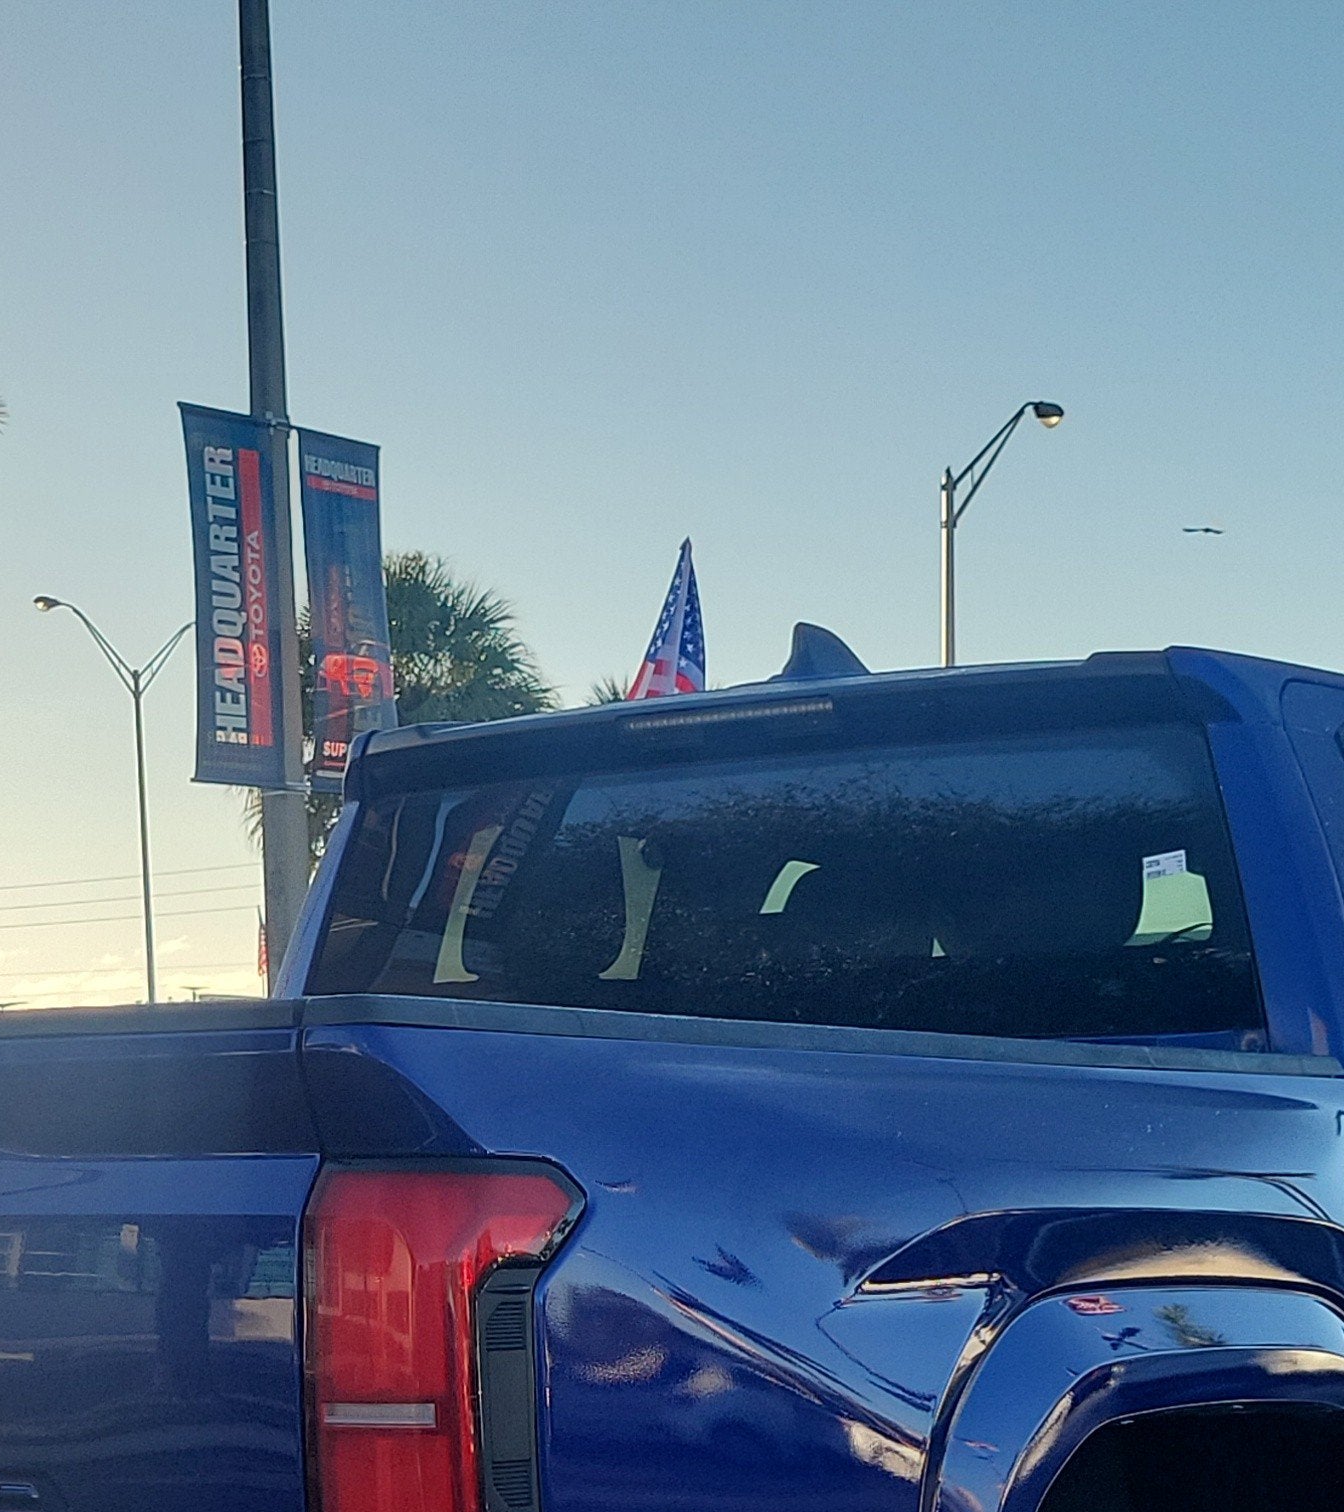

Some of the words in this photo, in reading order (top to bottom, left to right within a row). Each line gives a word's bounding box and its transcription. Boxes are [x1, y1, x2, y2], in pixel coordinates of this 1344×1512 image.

[304, 454, 376, 488] HEADQUARTER
[204, 445, 248, 744] HEADQUARTER
[245, 529, 265, 639] TOYOTA
